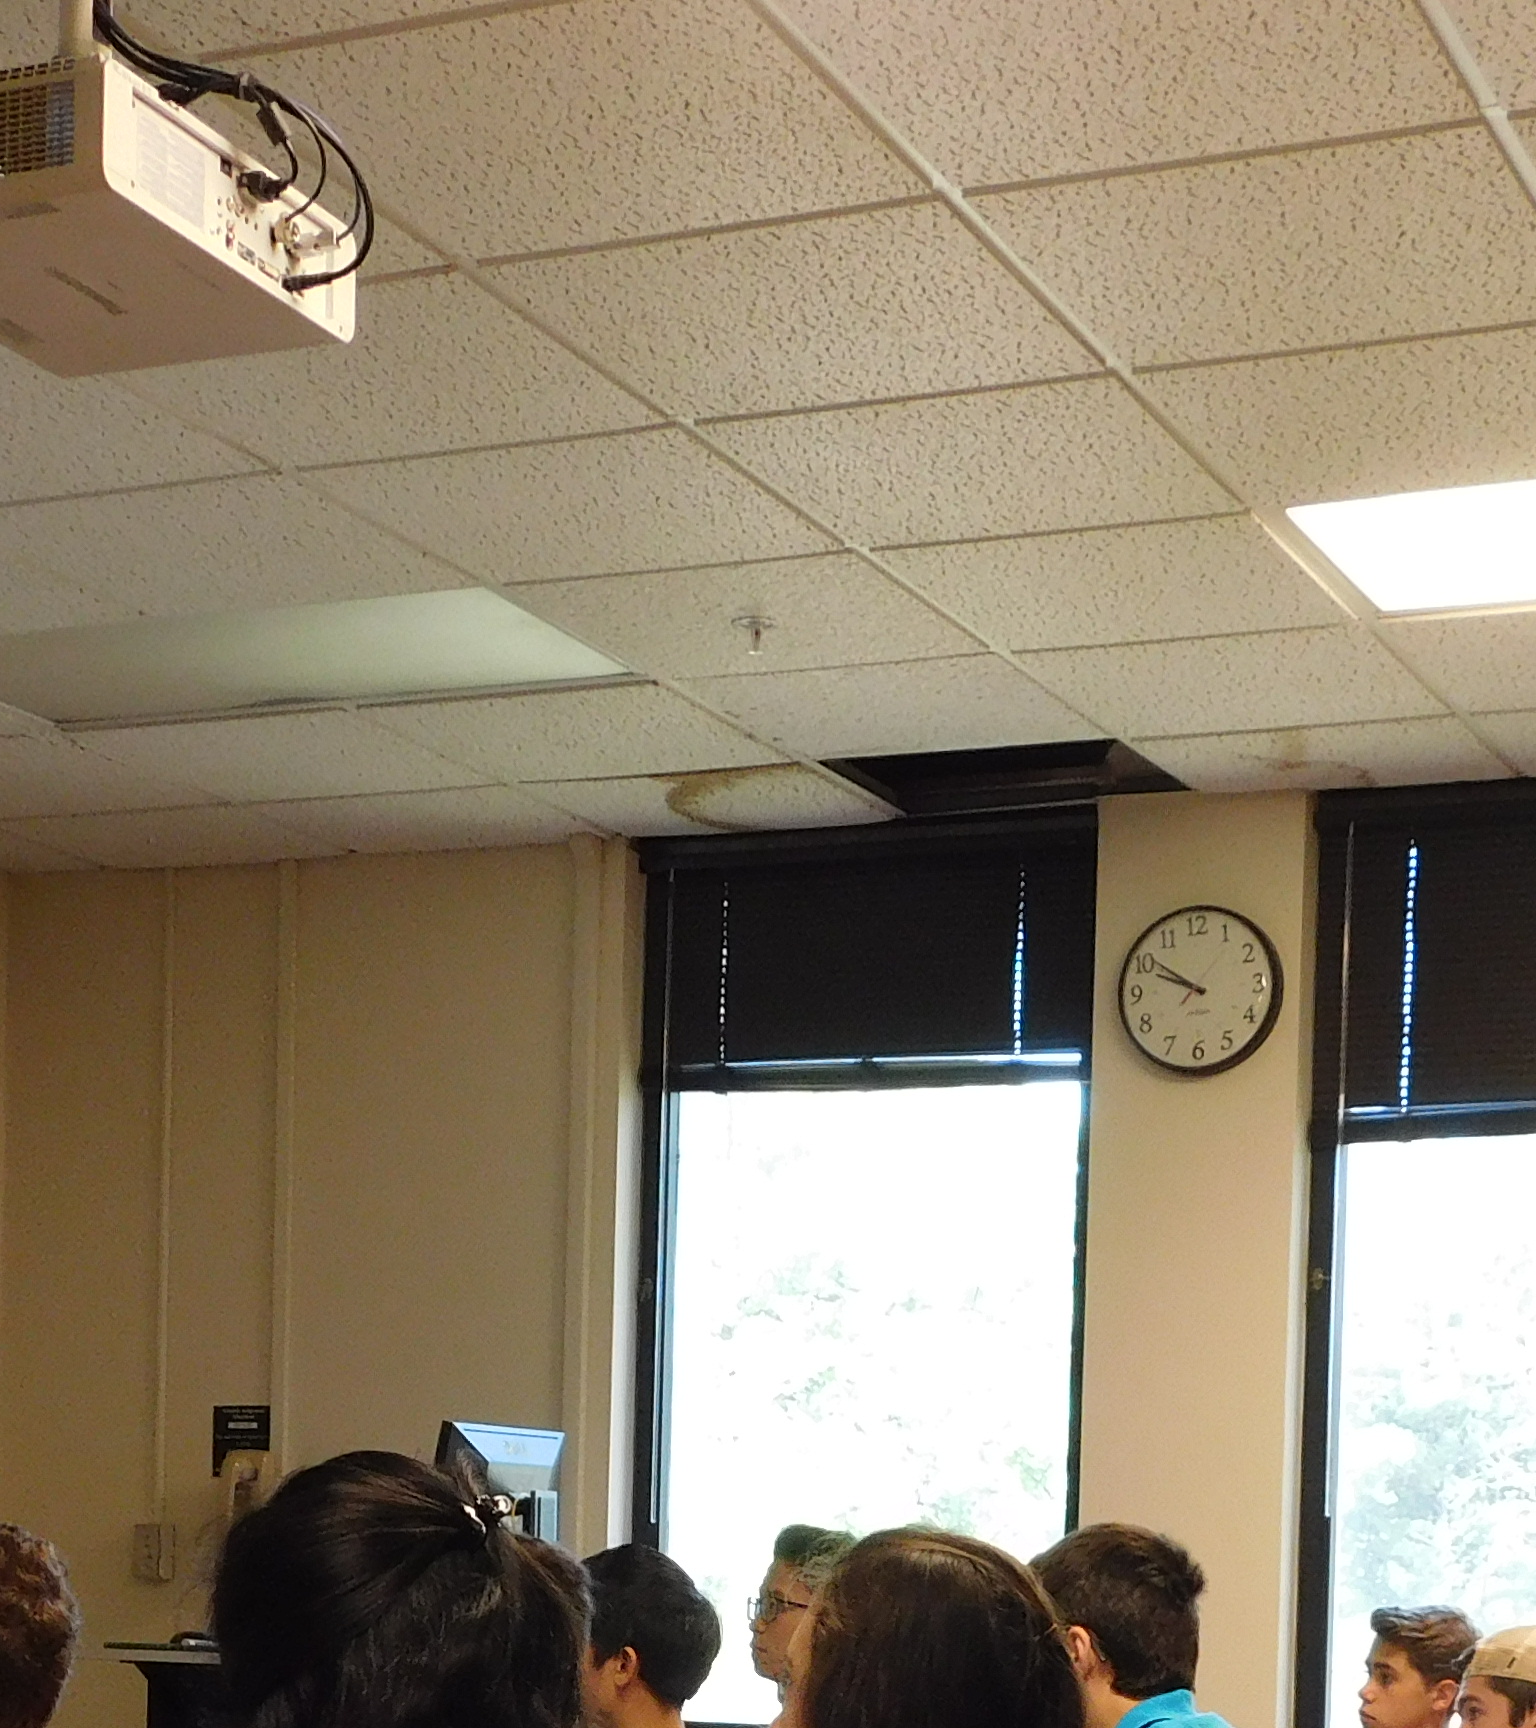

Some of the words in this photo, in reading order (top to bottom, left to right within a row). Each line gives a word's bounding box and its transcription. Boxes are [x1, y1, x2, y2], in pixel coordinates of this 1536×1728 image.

[1186, 915, 1208, 937] 12
[1222, 923, 1230, 943] 1
[1160, 930, 1176, 949] 11
[1135, 952, 1155, 974] 10
[1242, 943, 1255, 963] 2
[1252, 973, 1265, 993] 3
[1130, 984, 1143, 1005] 9
[1139, 1013, 1152, 1034] 8
[1243, 1004, 1256, 1024] 4
[1163, 1035, 1176, 1056] 7
[1192, 1040, 1205, 1060] 6
[1220, 1030, 1234, 1051] 5
